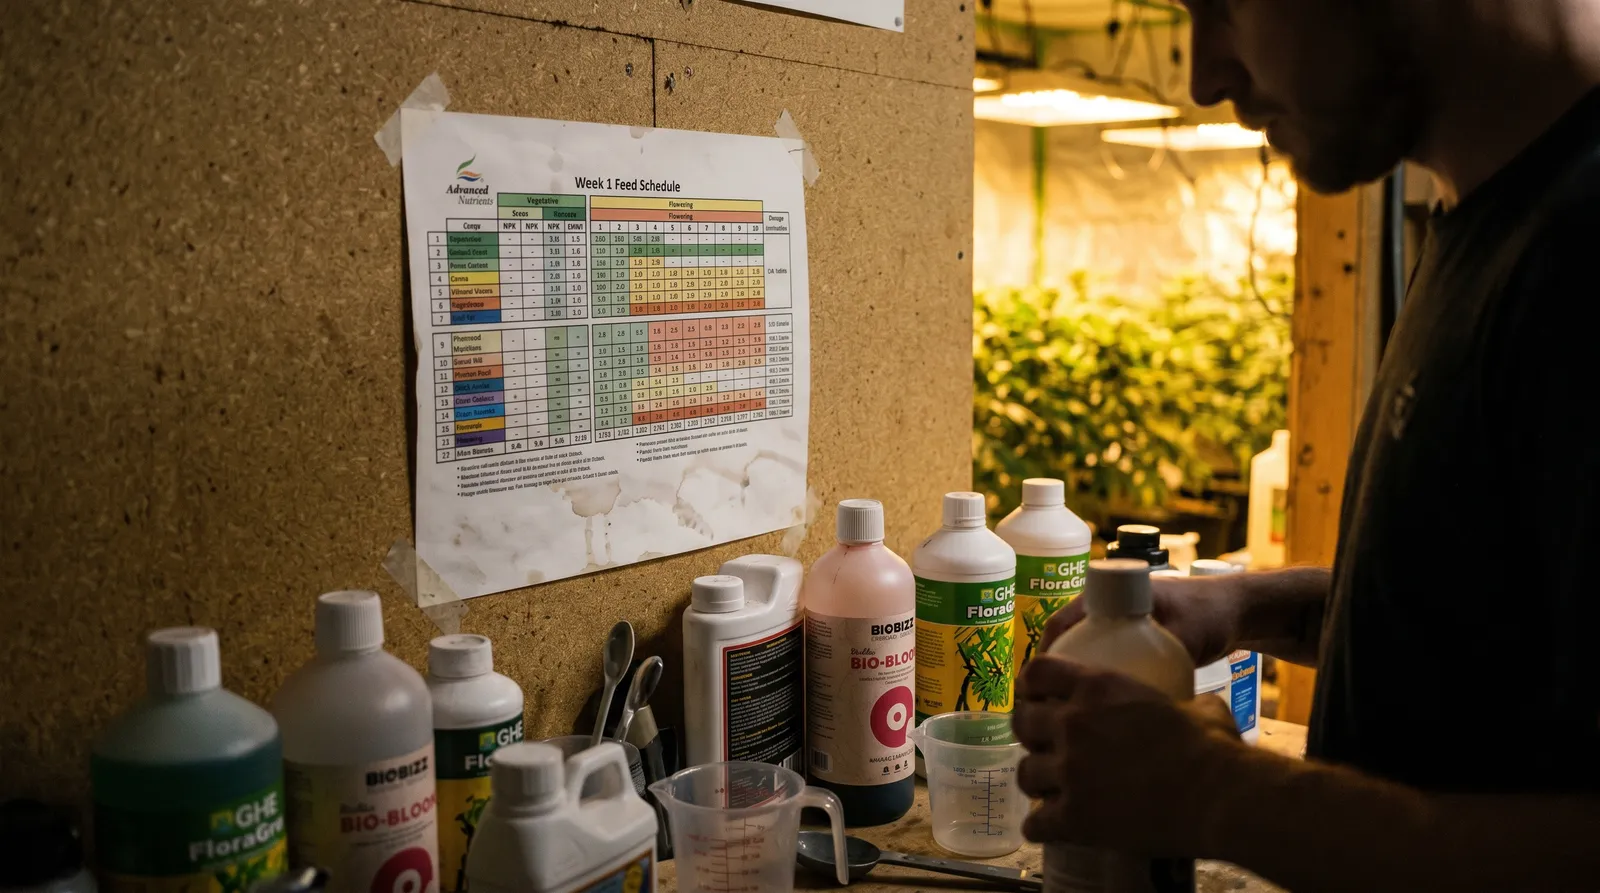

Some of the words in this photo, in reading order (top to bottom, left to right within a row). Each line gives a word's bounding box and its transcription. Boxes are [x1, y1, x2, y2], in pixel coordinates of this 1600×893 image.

[446, 185, 489, 195] Advanced
[575, 177, 603, 189] Week
[607, 178, 612, 189] 1
[615, 179, 637, 190] Feed
[639, 179, 680, 192] Schedule
[458, 196, 493, 205] Nutrients
[1058, 560, 1086, 576] GHE
[994, 582, 1016, 601] GHE
[871, 617, 914, 635] BIOBIZZ
[497, 720, 522, 746] GHE
[366, 756, 428, 786] BIOBIZZ
[236, 790, 278, 828] GHE
